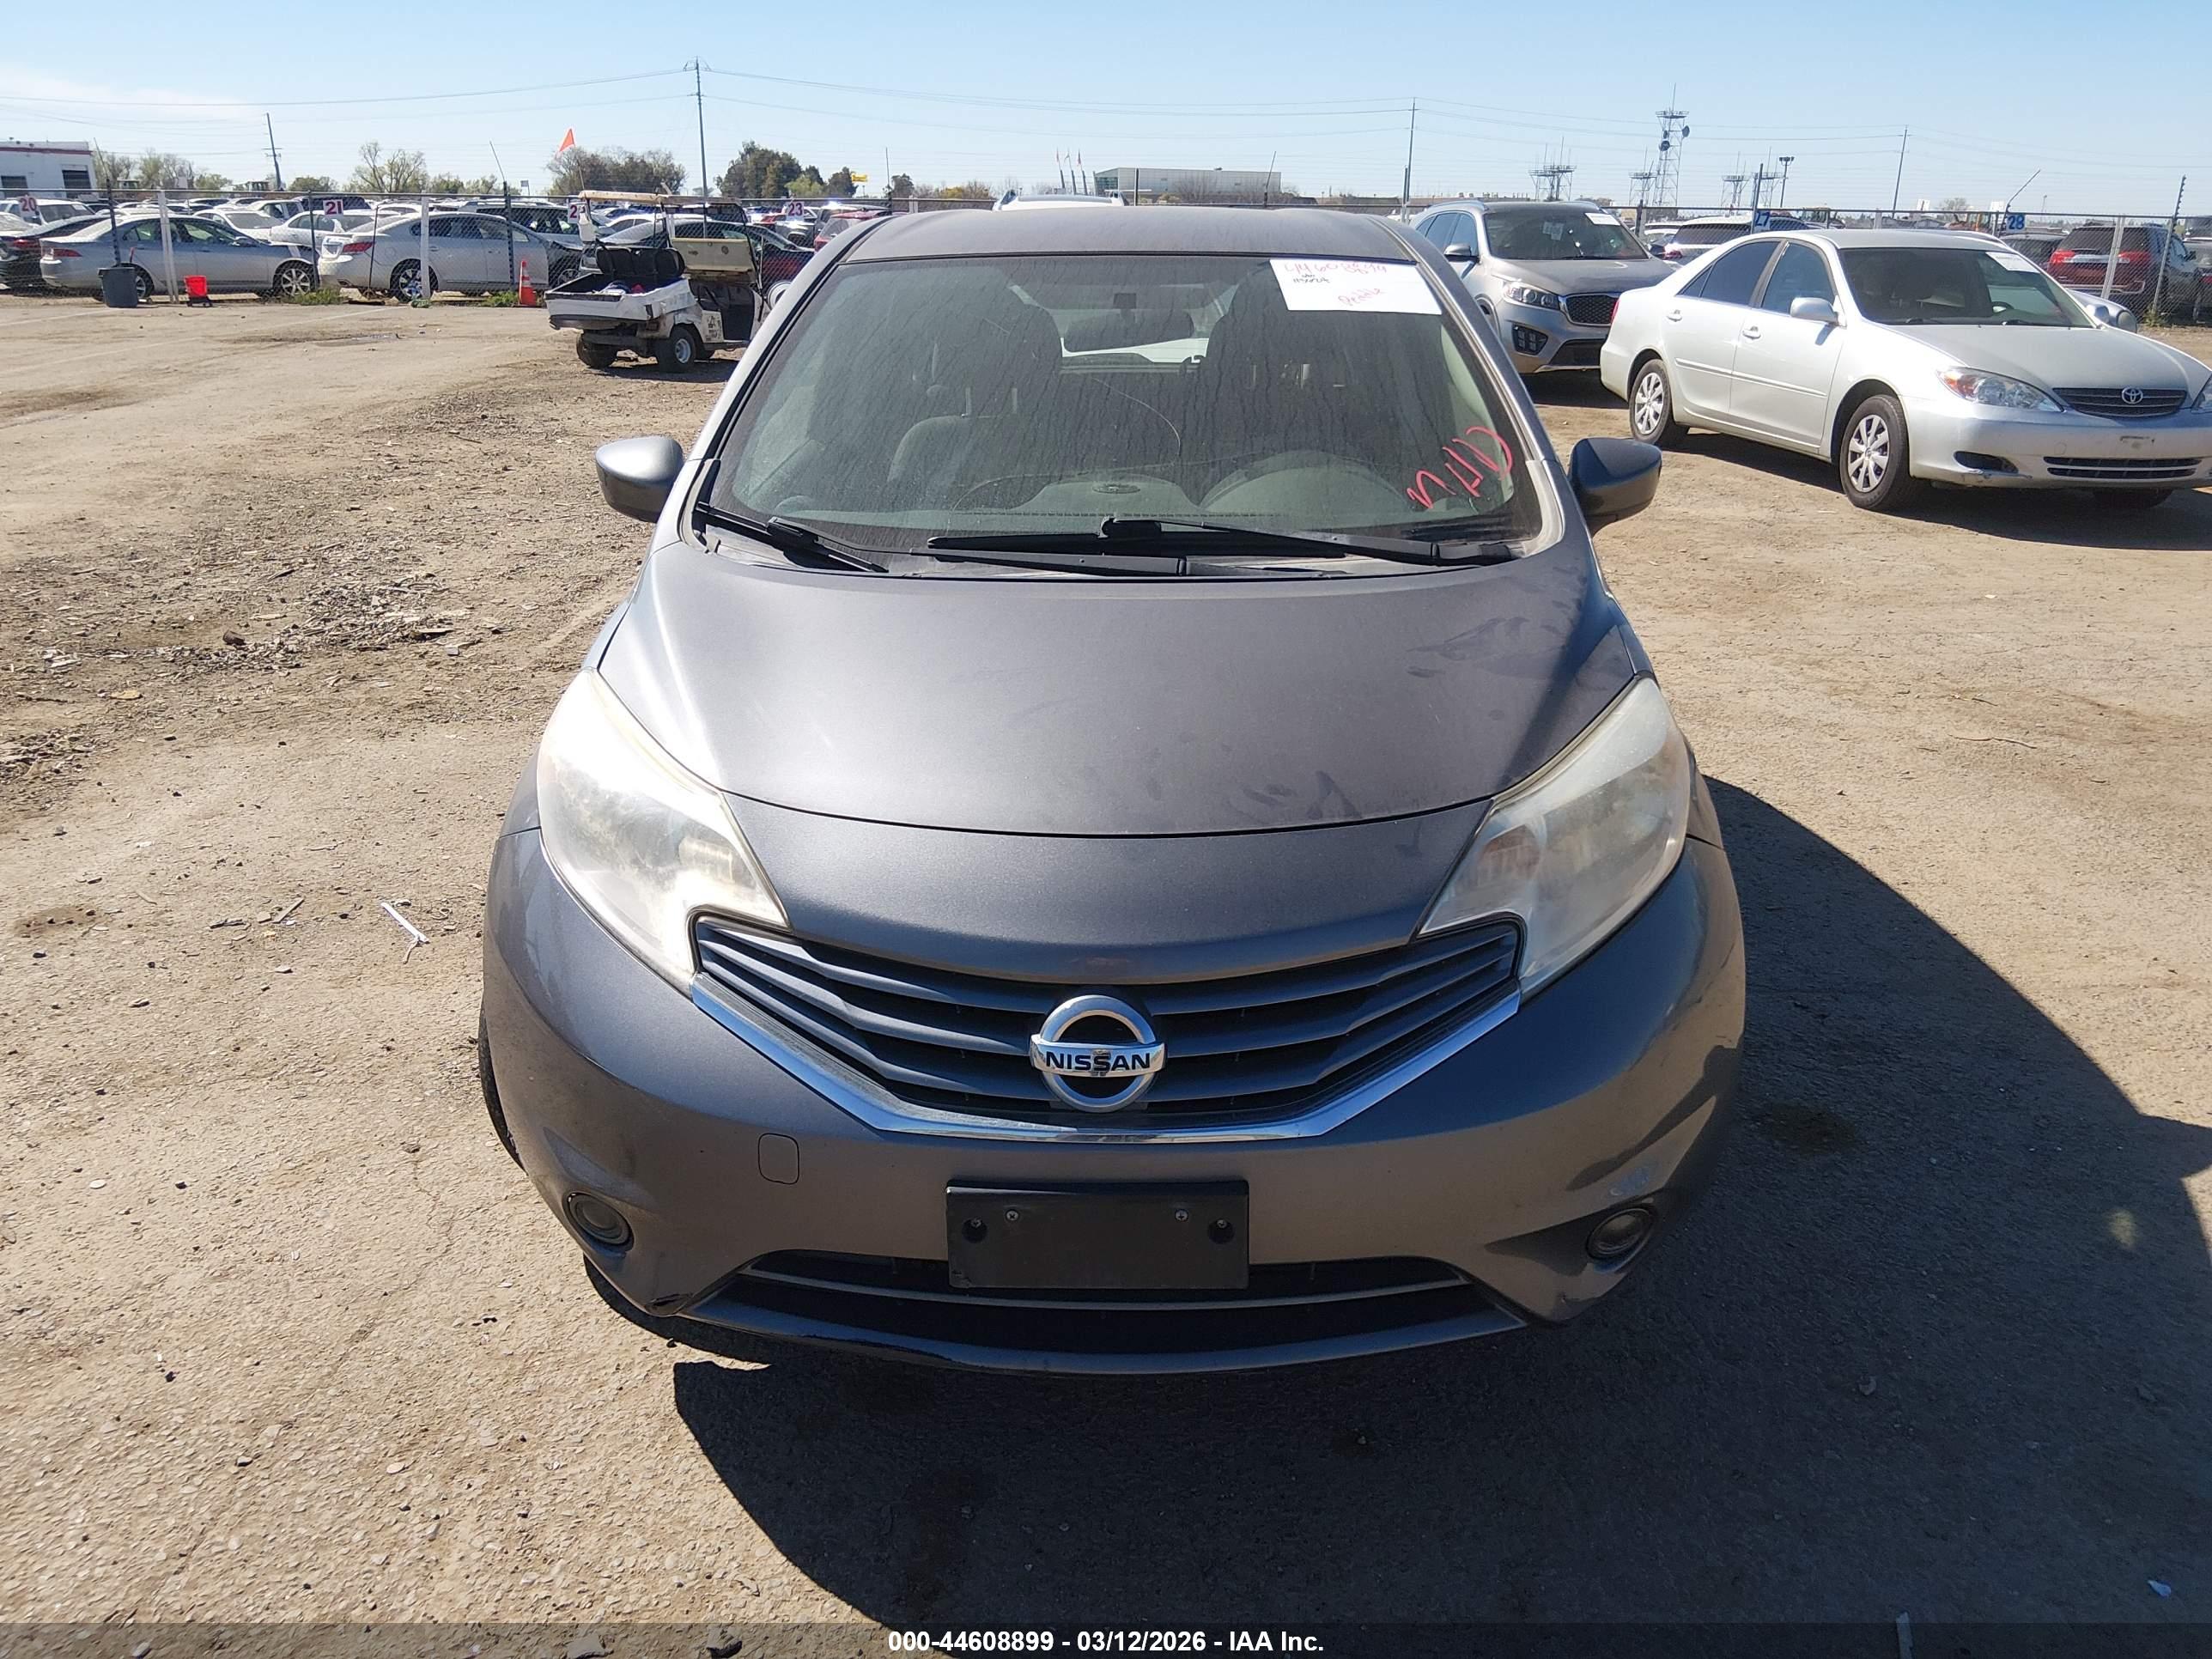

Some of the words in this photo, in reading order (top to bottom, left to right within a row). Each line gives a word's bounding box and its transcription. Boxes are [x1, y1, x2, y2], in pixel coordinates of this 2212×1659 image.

[20, 198, 37, 211] 20
[325, 201, 343, 216] 21
[788, 203, 803, 216] 23
[1755, 210, 1770, 226] 27
[2008, 215, 2025, 230] 28
[1046, 1052, 1150, 1072] NISSAN
